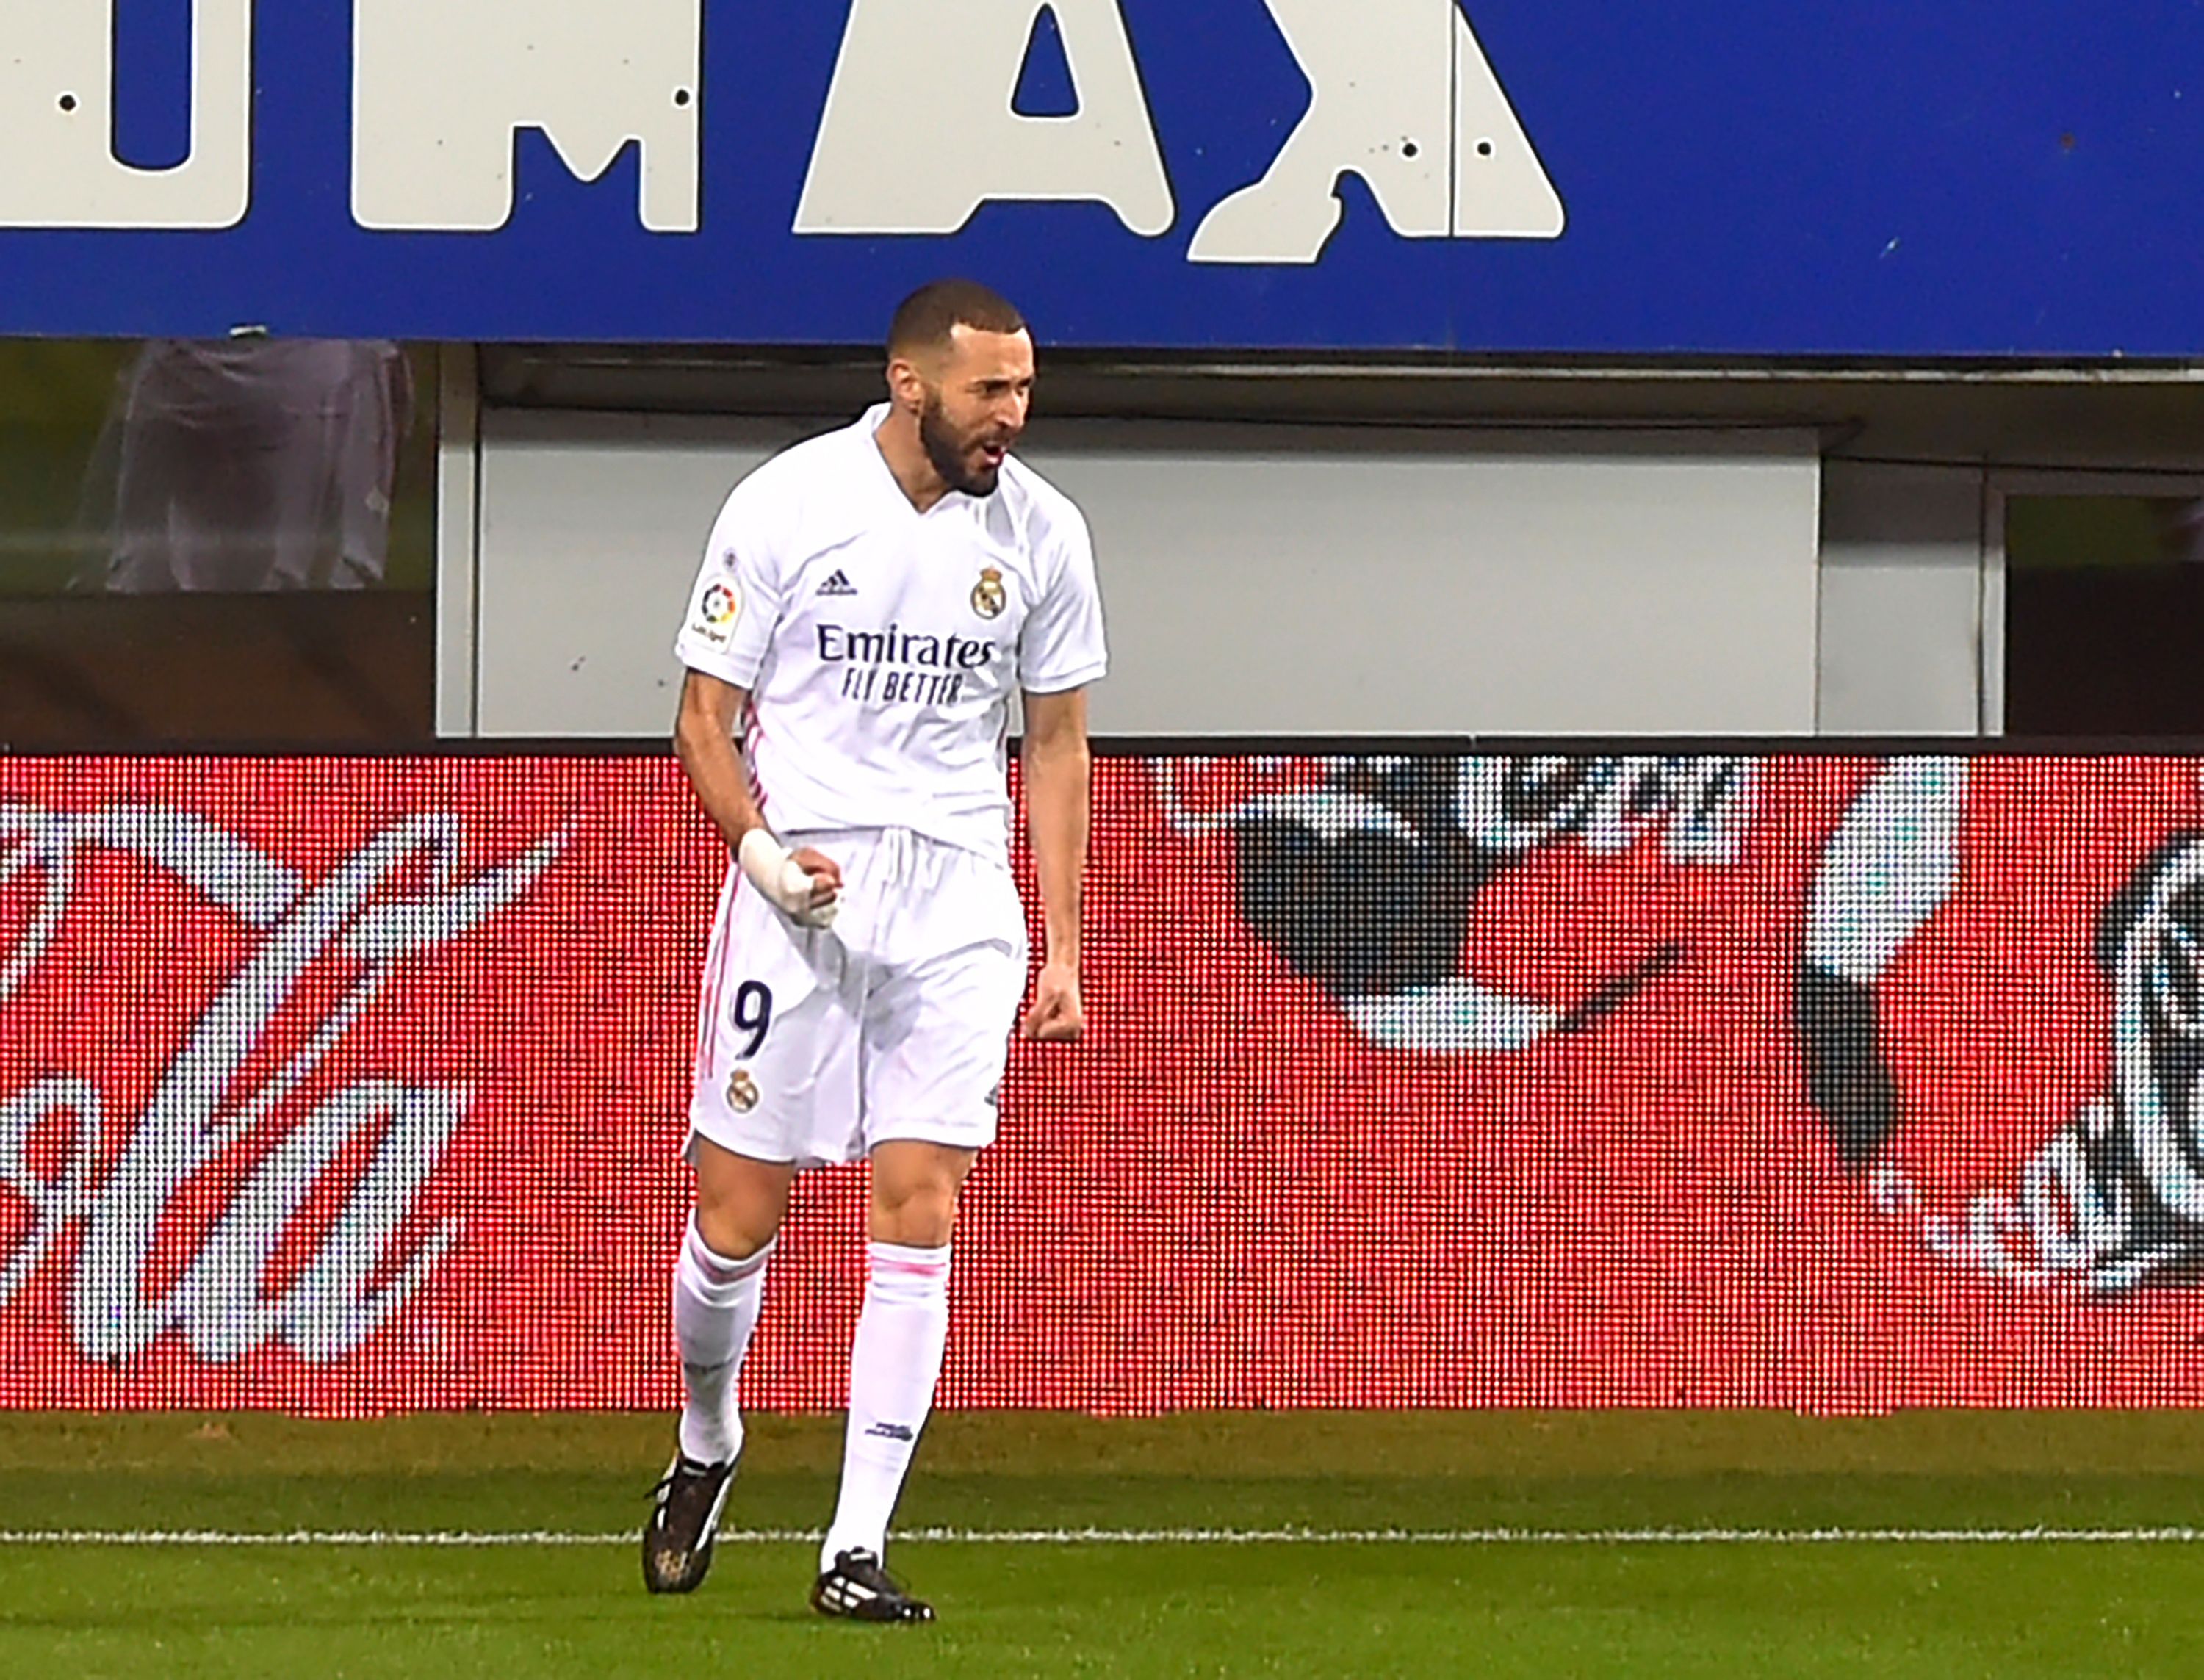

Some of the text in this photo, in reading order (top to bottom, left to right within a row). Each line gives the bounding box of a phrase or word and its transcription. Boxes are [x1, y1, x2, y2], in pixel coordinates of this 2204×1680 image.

[816, 623, 996, 668] Emirates
[882, 671, 963, 707] BETTER
[735, 981, 772, 1060] 9
[0, 804, 580, 1365] ola
